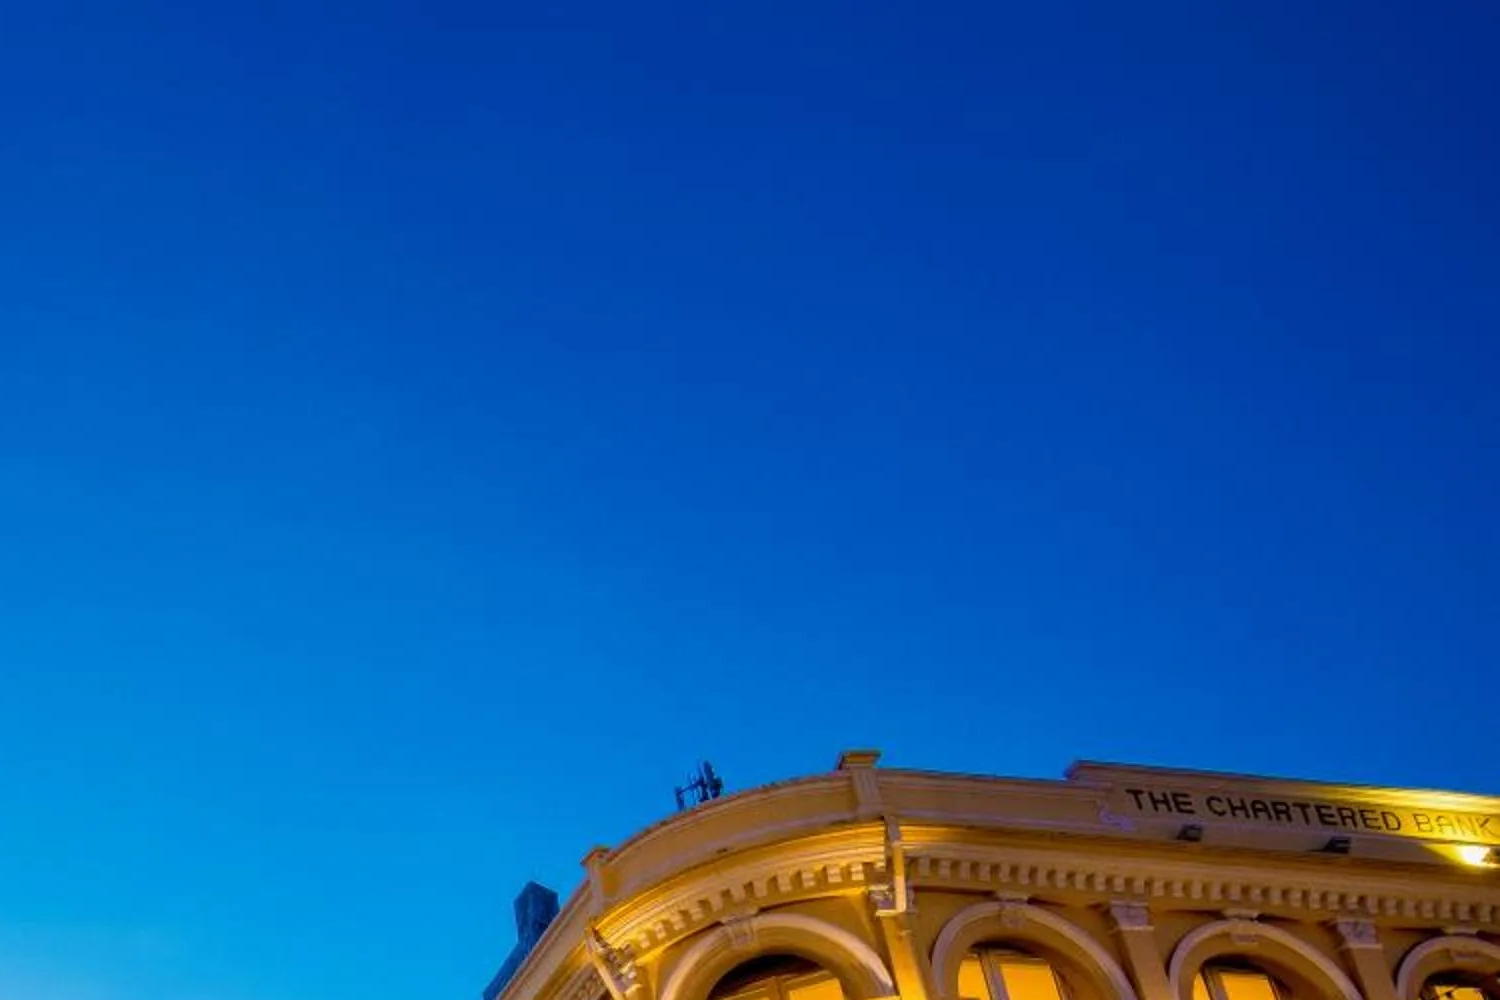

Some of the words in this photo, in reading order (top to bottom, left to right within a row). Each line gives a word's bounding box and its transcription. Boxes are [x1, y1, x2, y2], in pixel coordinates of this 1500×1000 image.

[1125, 788, 1197, 815] THE
[1204, 795, 1401, 832] CHARTERED
[1411, 813, 1500, 839] BANK
